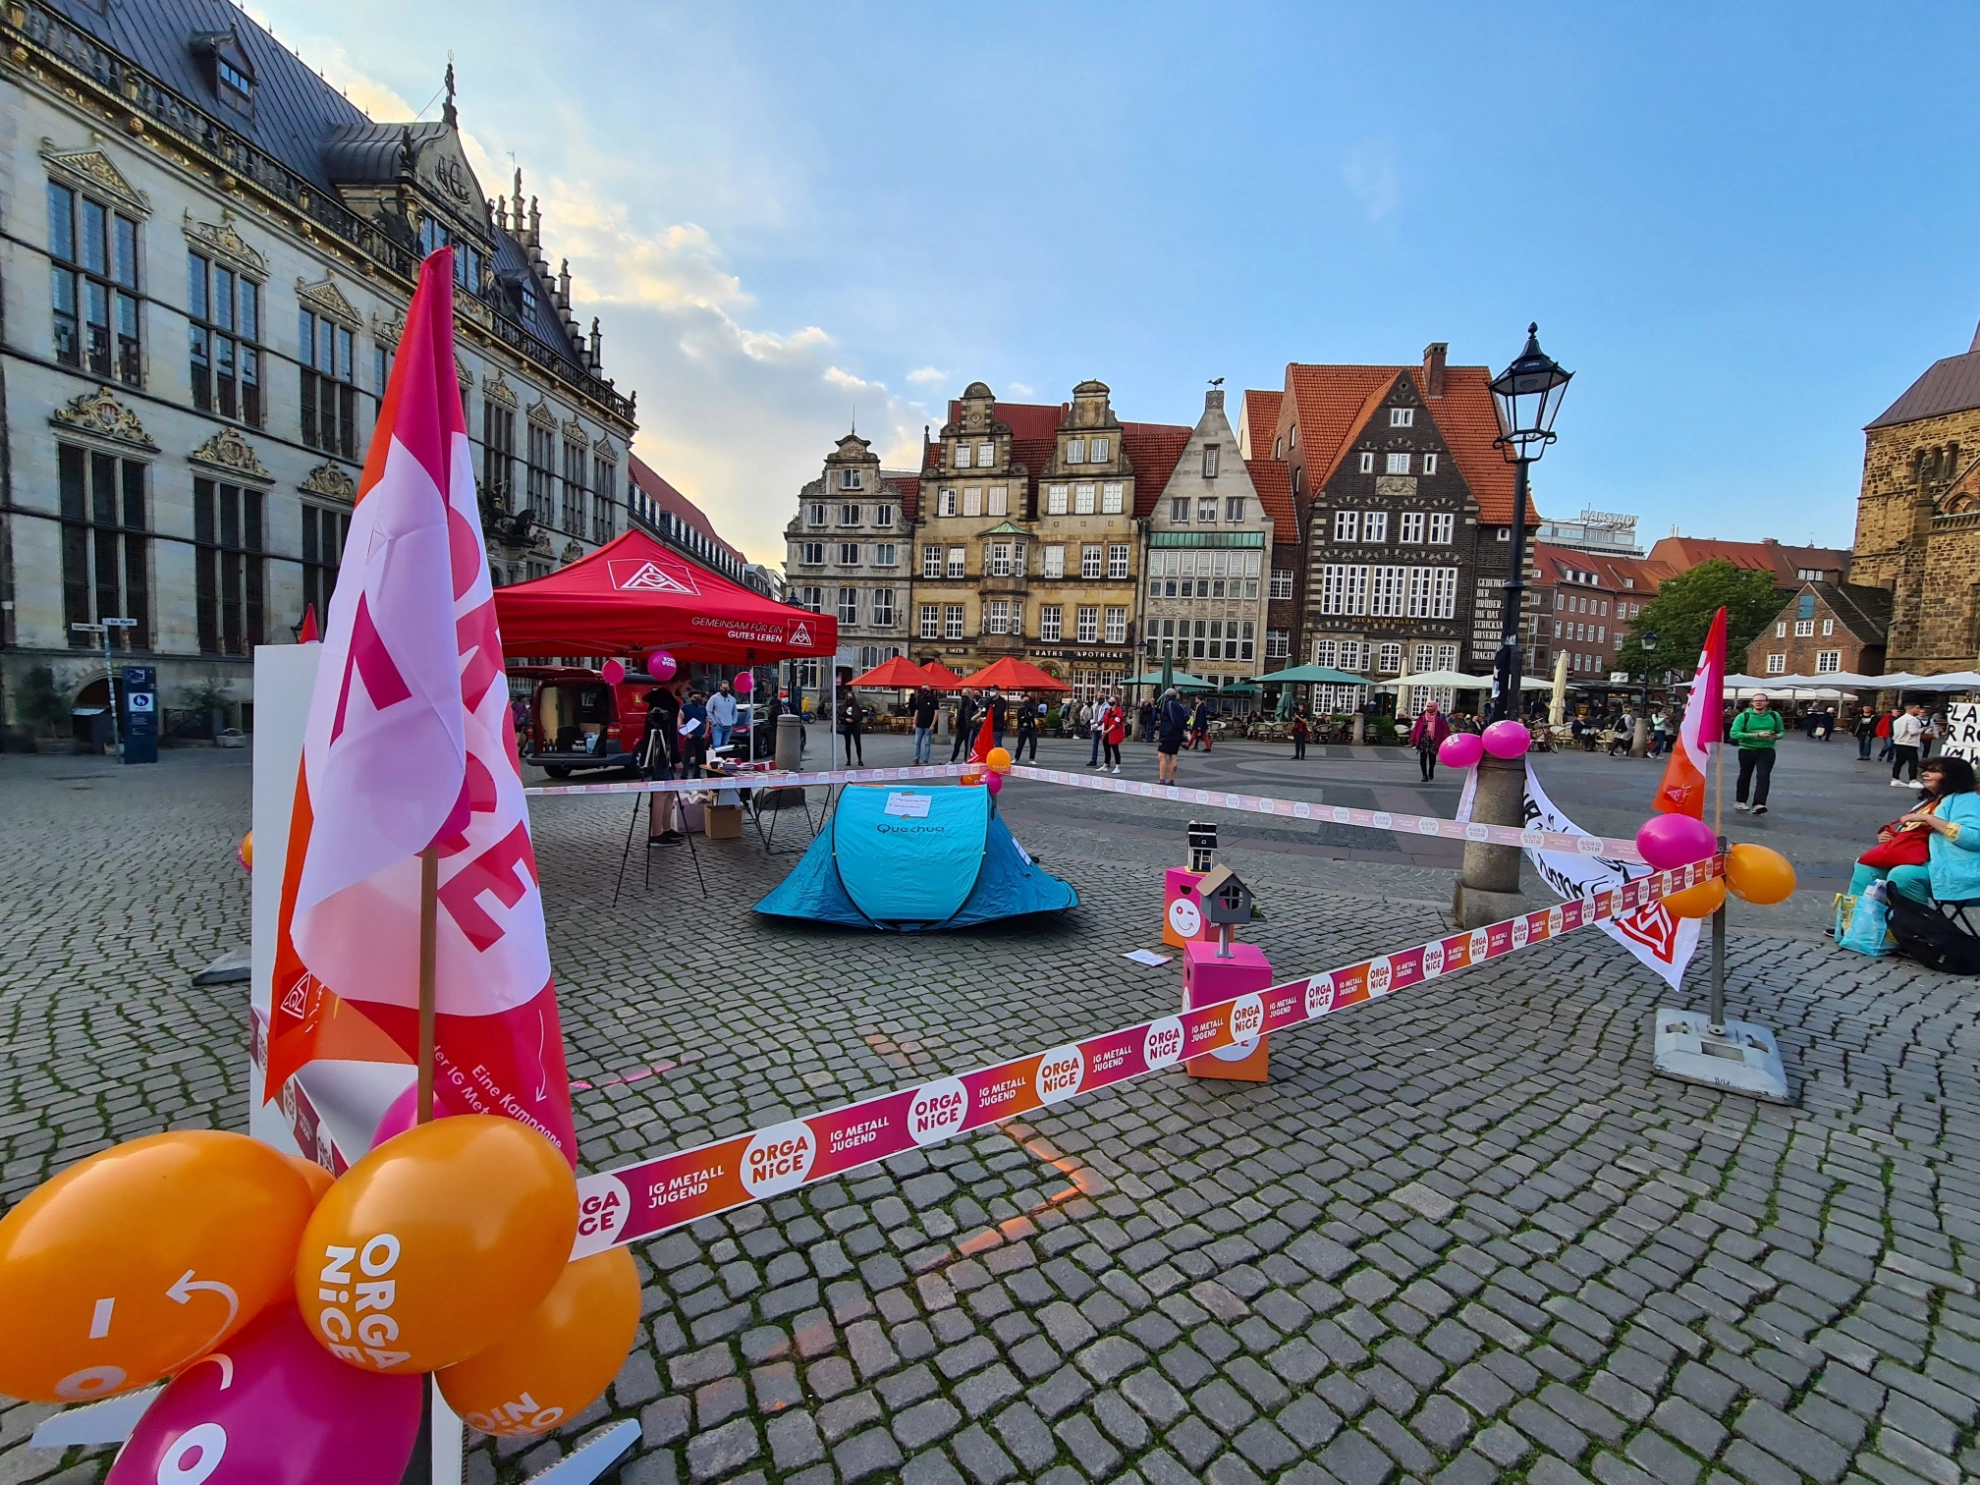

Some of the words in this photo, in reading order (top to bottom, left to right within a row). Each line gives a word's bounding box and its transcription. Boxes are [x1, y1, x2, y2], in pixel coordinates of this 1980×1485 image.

[1580, 510, 1639, 526] KARSTADT
[1476, 588, 1490, 598] DER
[1474, 610, 1486, 618] DIE
[1486, 610, 1500, 619] DAS
[691, 616, 750, 630] GEMEINSAM
[750, 622, 768, 633] FÜR
[768, 624, 784, 634] EIN
[1474, 620, 1503, 630] SCHICKSA
[728, 630, 755, 641] GUTES
[756, 633, 783, 643] LEBEN
[1035, 650, 1064, 658] RATHS
[1076, 650, 1124, 659] APOTHEKE
[1946, 705, 1978, 723] PLA
[877, 824, 945, 834] Quechua
[1514, 923, 1528, 934] ORGA
[1471, 936, 1487, 948] ORGA
[1425, 950, 1442, 962] ORGA
[1345, 976, 1363, 987] METALL
[1370, 966, 1390, 980] ORGA
[1308, 982, 1332, 998] ORGA
[1276, 996, 1298, 1008] METALL
[1234, 1004, 1260, 1021] ORGA
[1270, 1006, 1292, 1018] JUGEND
[1200, 1018, 1224, 1032] METALL
[1148, 1028, 1181, 1047] ORGA
[1191, 1029, 1217, 1042] JUGEND
[1103, 1045, 1132, 1061] METALL
[1041, 1057, 1080, 1080] ORGA
[1092, 1057, 1124, 1074] JUGEND
[471, 1064, 501, 1097] Eine
[979, 1088, 990, 1098] IG
[991, 1076, 1026, 1094] METALL
[446, 1066, 465, 1086] IG
[461, 1086, 490, 1115] Met
[978, 1089, 1016, 1108] JUGEND
[914, 1092, 962, 1116] ORGA
[830, 1130, 843, 1142] IG
[845, 1116, 890, 1139] METALL
[749, 1136, 808, 1166] ORGA
[829, 1131, 877, 1154] JUGEND
[648, 1182, 665, 1196] IG
[668, 1165, 725, 1191] METALL
[580, 1191, 620, 1215] GA
[648, 1182, 708, 1209] JUGEND
[578, 1210, 615, 1236] CE
[355, 1233, 412, 1369] ORGA
